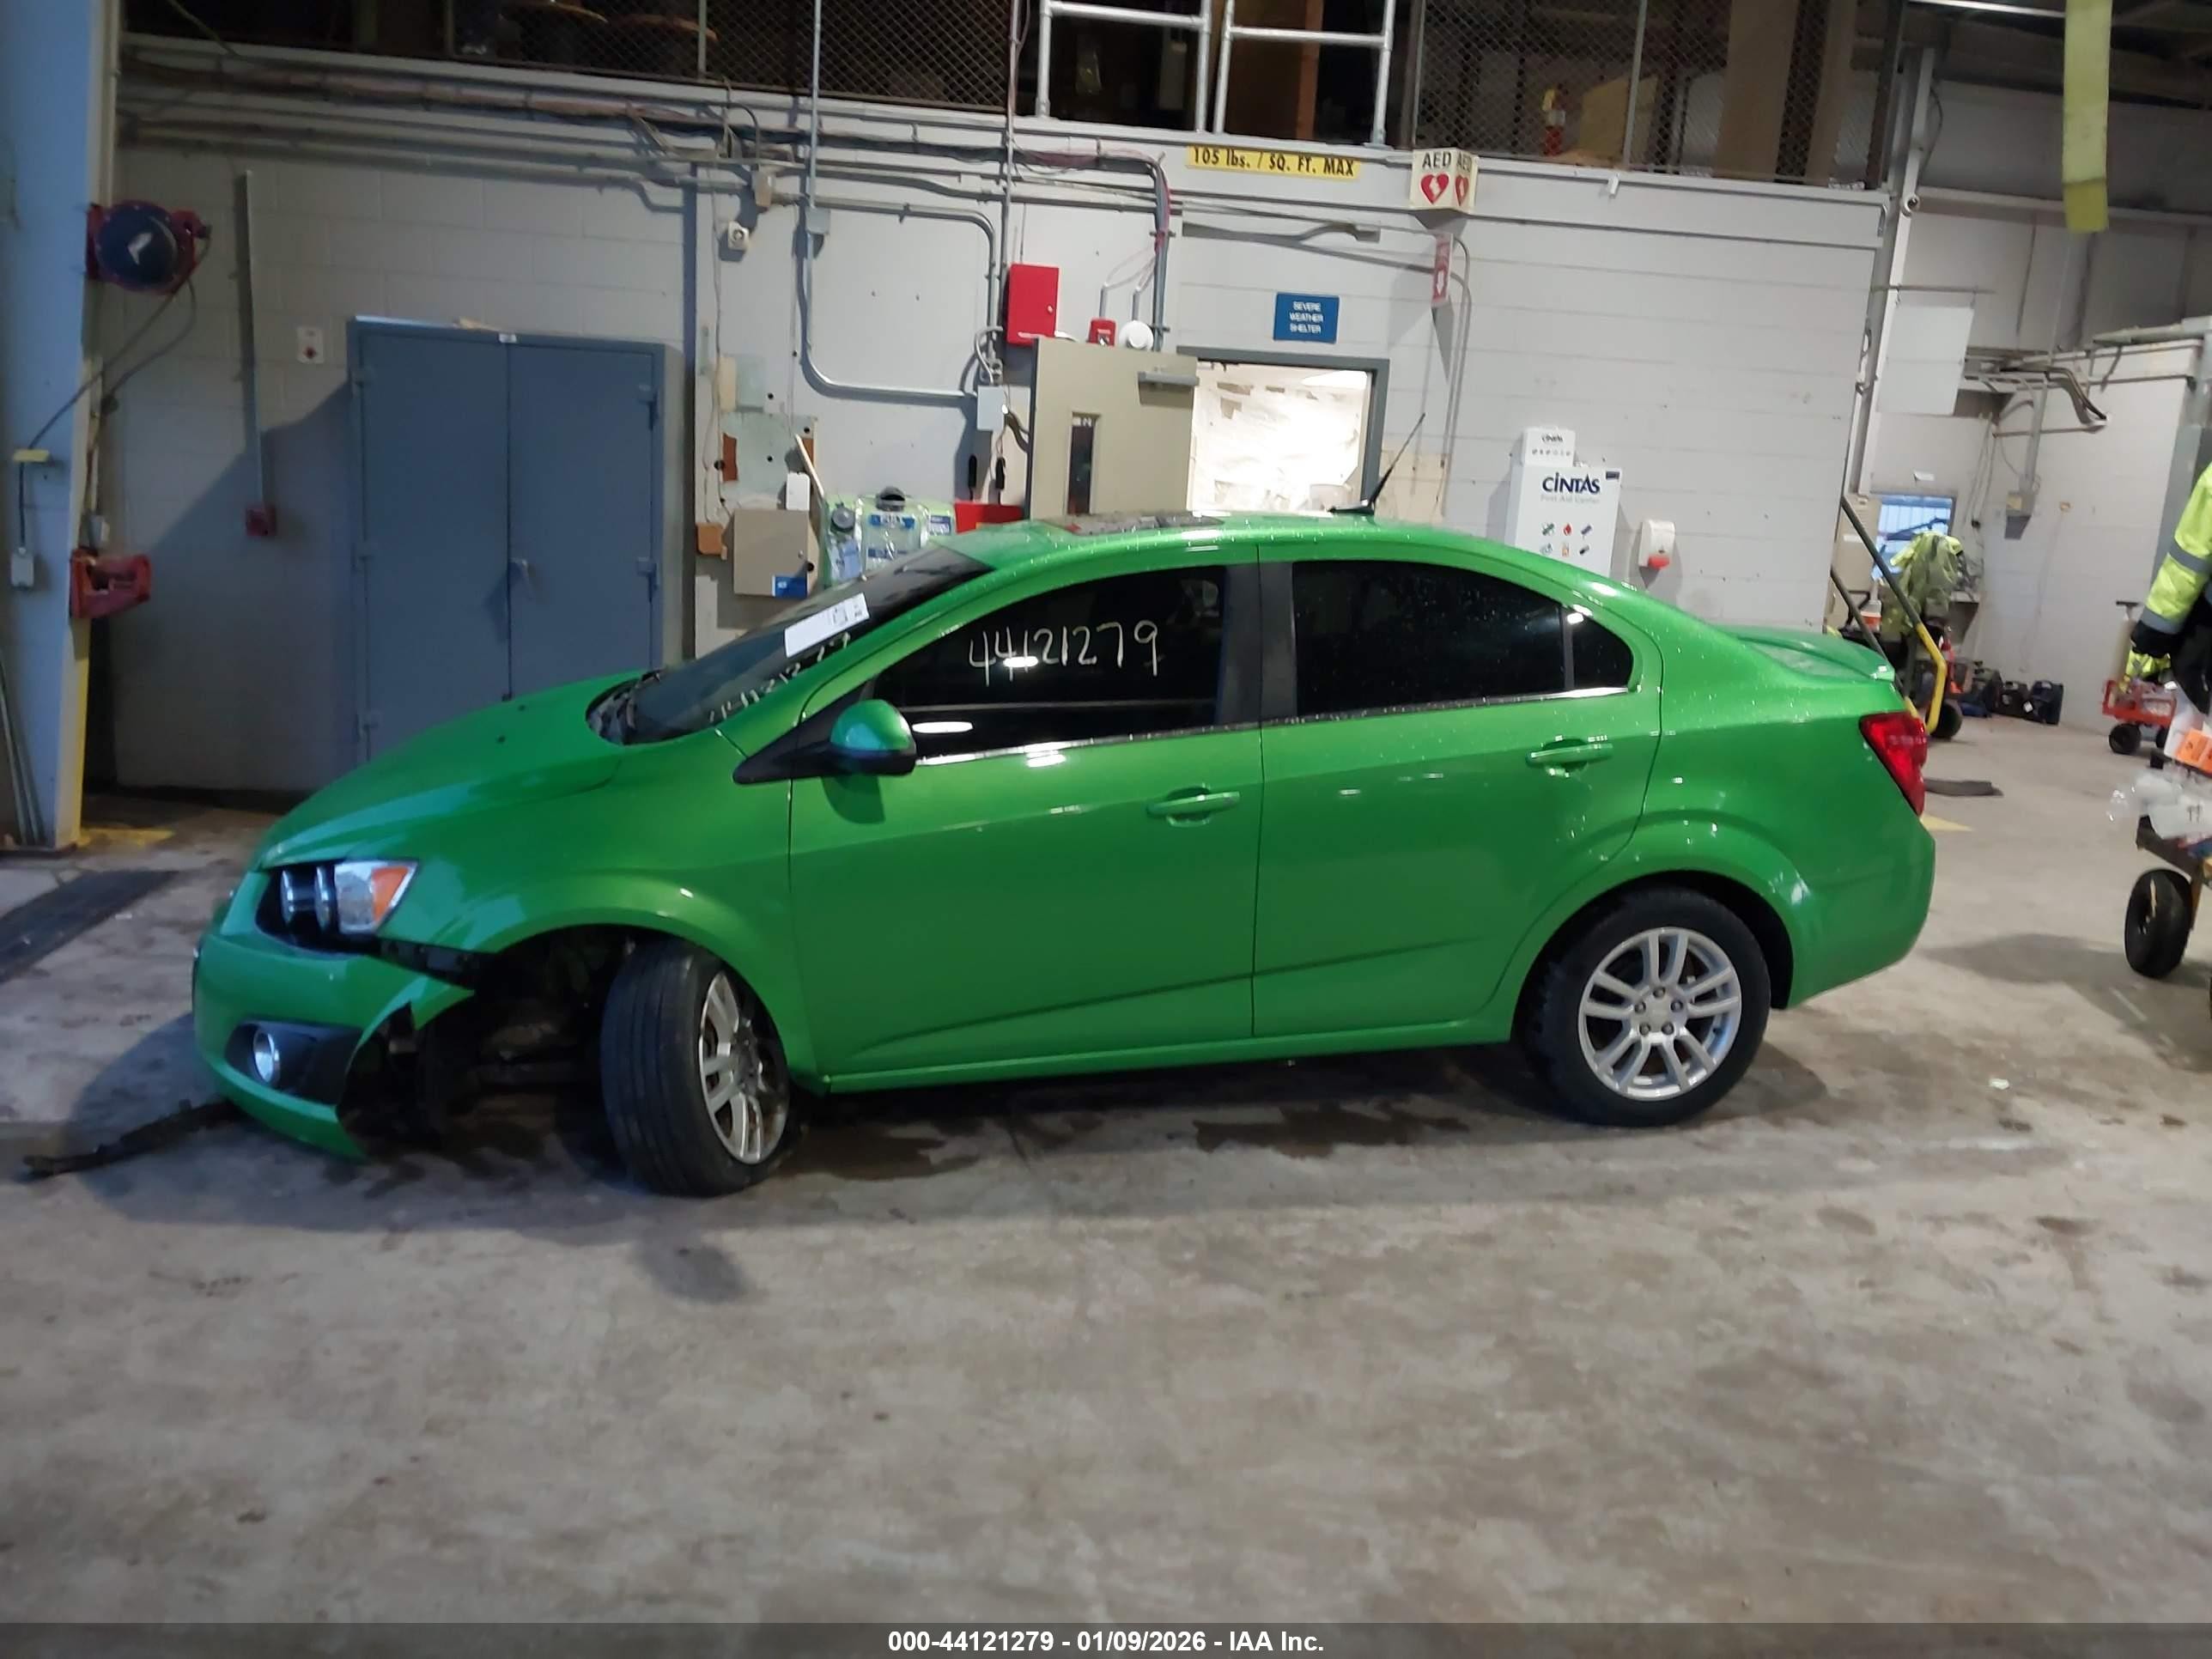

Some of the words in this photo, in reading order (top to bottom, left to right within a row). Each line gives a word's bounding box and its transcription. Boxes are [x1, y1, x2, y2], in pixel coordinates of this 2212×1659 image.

[1194, 146, 1220, 164] 105
[1226, 148, 1251, 168] lbs.
[1256, 150, 1264, 168] /
[1268, 152, 1291, 172] SQ.
[1297, 155, 1316, 174] FT.
[1322, 157, 1354, 177] MAX
[1422, 152, 1452, 168] AED
[1293, 301, 1322, 312] SEVERE
[1289, 312, 1324, 323] WEATHER
[1290, 323, 1322, 334] SHELTER
[1542, 471, 1601, 495] CINTAS
[969, 620, 1158, 686] 44121279
